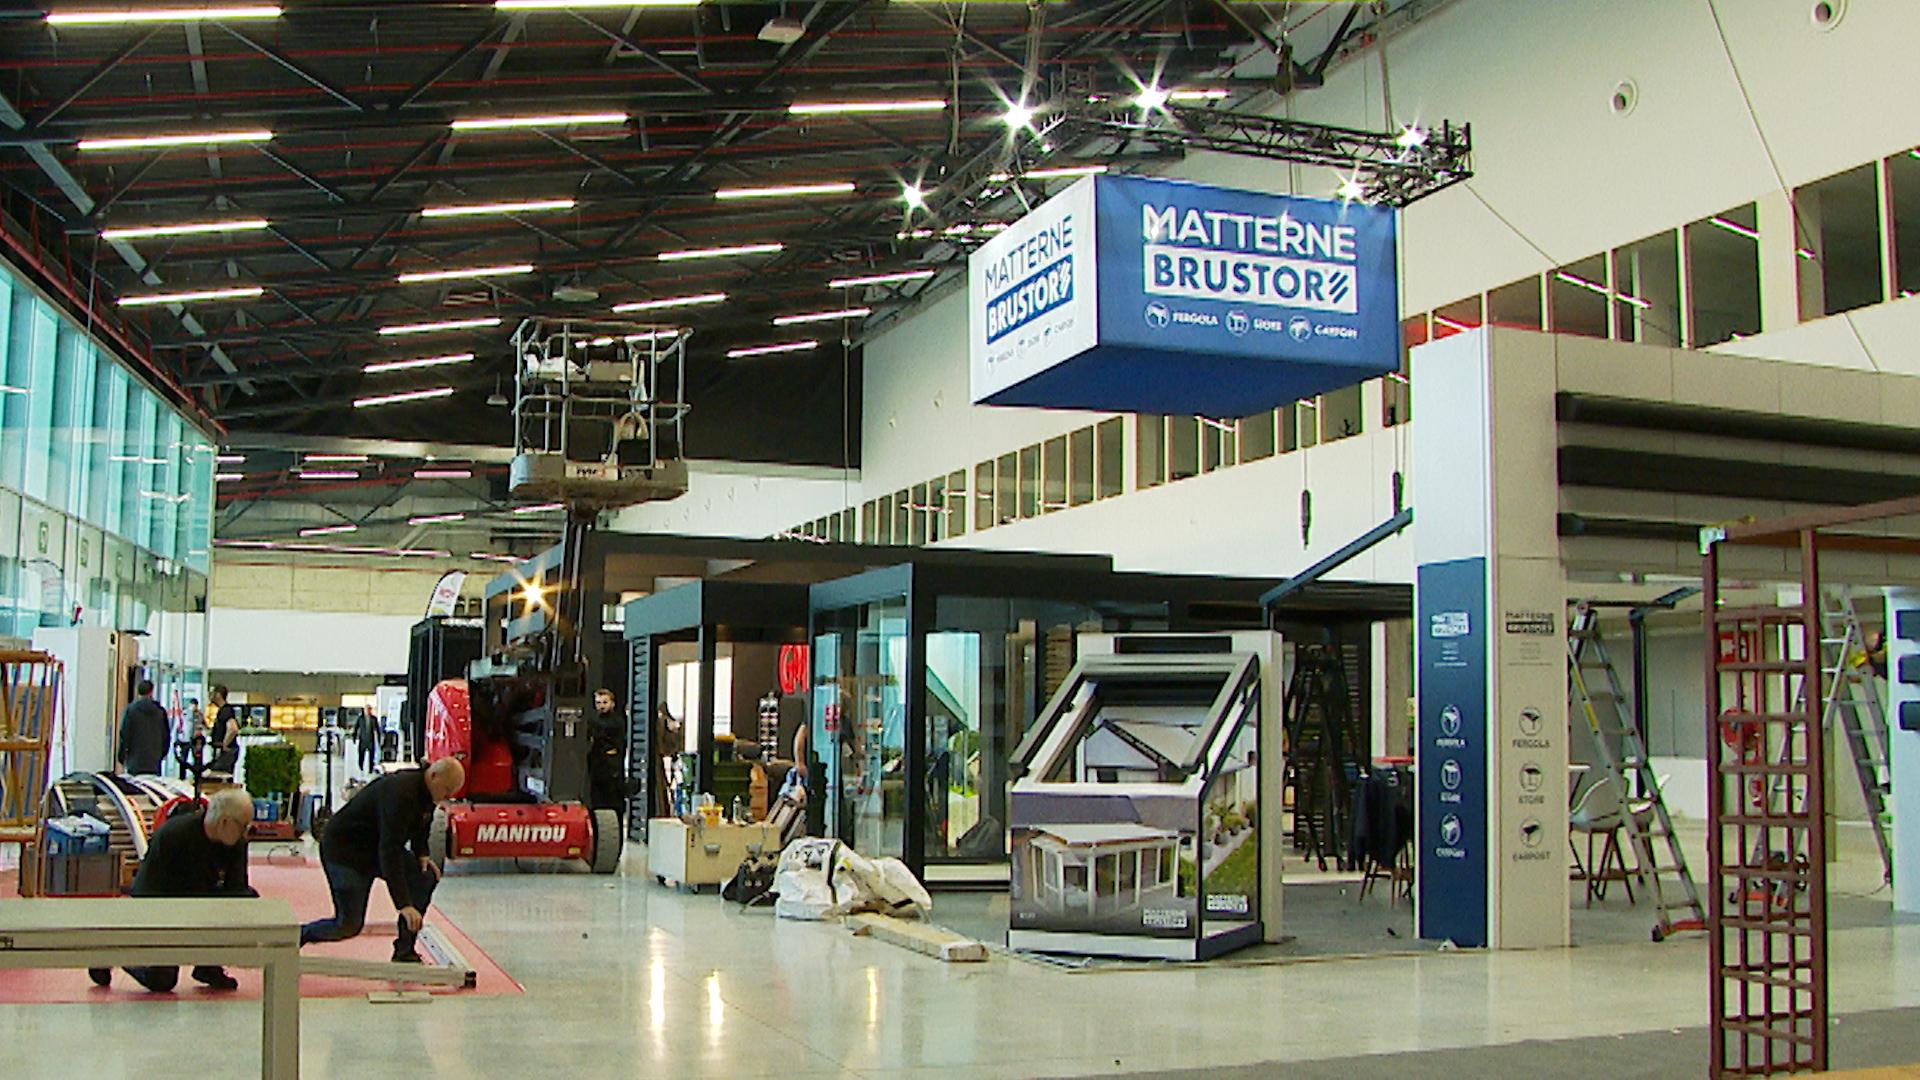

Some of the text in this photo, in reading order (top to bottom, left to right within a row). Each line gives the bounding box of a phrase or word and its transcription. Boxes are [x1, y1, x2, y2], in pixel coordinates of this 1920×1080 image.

[985, 214, 1073, 298] MATTERNE
[1143, 204, 1356, 260] MATTERNE
[988, 269, 1060, 337] BRUSTOR
[1154, 253, 1324, 302] BRUSTOR
[477, 824, 567, 842] MANITOU
